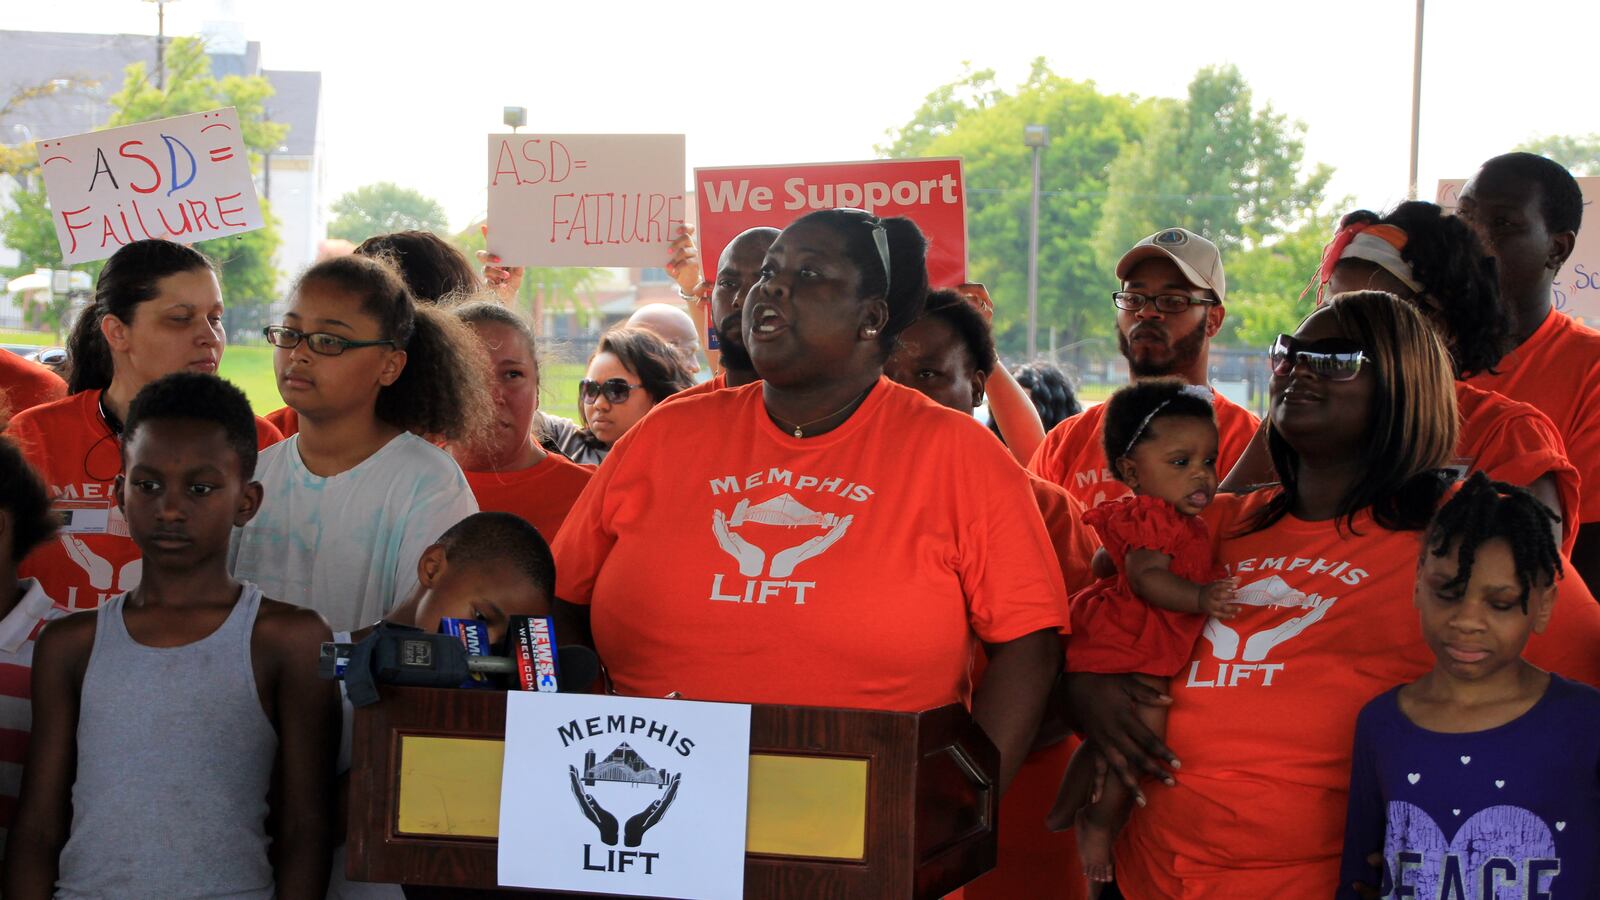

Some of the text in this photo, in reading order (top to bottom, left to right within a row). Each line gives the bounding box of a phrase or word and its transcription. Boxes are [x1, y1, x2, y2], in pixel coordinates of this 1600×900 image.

[703, 173, 958, 213] We Support
[551, 192, 685, 246] FAILURE
[709, 467, 875, 502] MEMPHIS
[709, 573, 816, 605] LIFT
[1185, 660, 1285, 689] LIFT
[557, 714, 696, 757] MEMPHIS
[583, 843, 660, 875] LIFT
